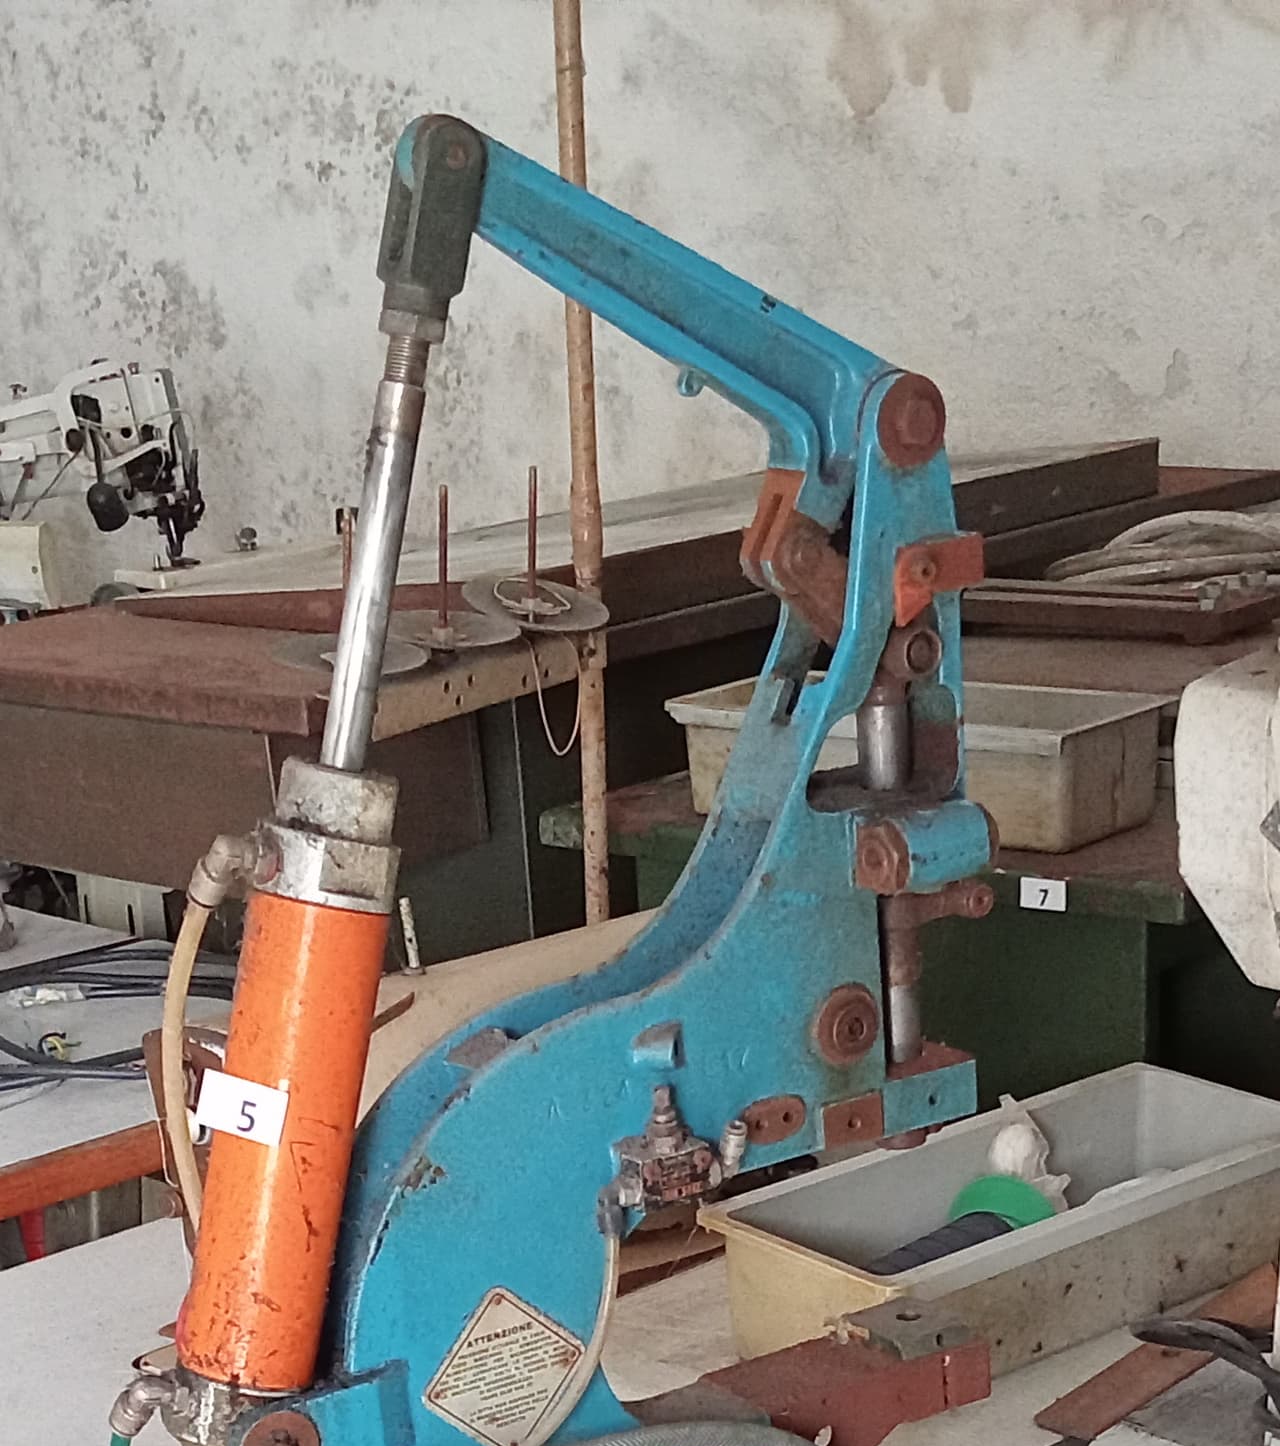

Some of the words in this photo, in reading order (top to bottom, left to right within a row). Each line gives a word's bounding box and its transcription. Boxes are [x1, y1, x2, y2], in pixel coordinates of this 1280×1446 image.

[1039, 888, 1049, 907] 7
[236, 1100, 257, 1132] 5
[466, 1321, 533, 1348] ATTENZIONE
